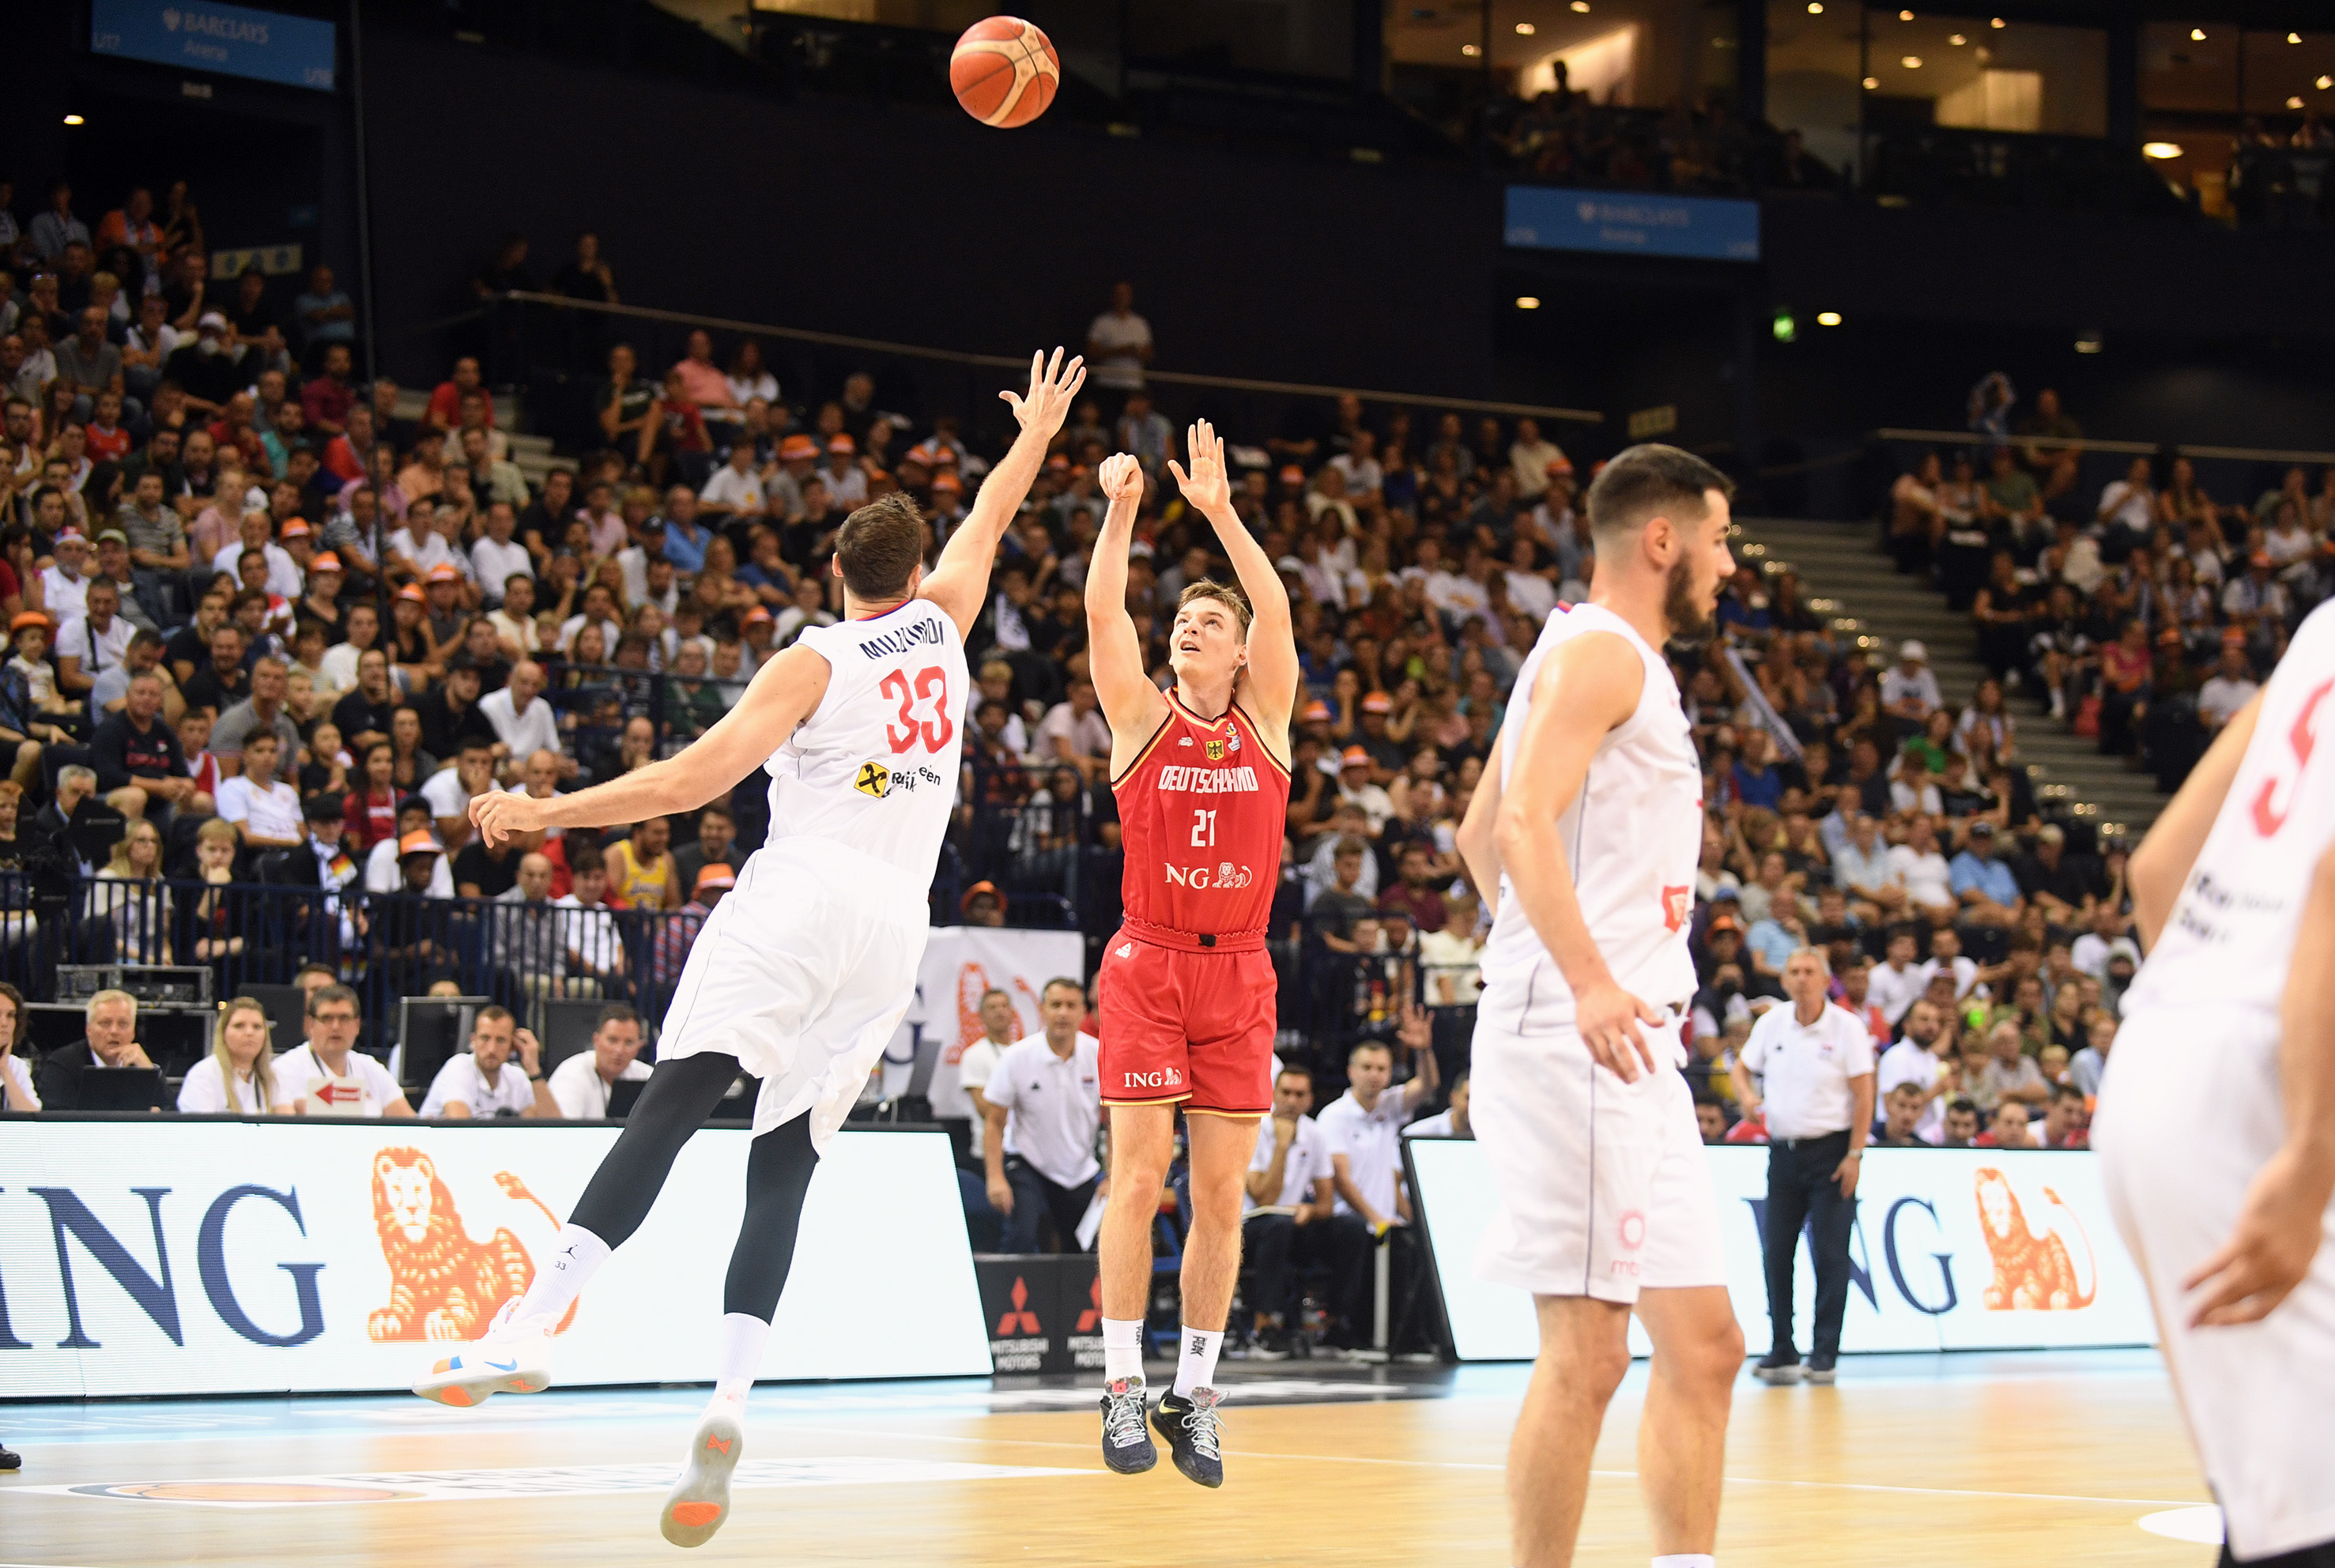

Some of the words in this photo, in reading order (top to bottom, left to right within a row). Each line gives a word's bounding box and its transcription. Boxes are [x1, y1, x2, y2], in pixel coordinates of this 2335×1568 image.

[879, 665, 953, 754] 33
[1158, 765, 1259, 793] DEUTSCHLAND
[1191, 809, 1217, 847] 21
[1124, 1072, 1163, 1087] ING
[555, 1261, 567, 1271] 33
